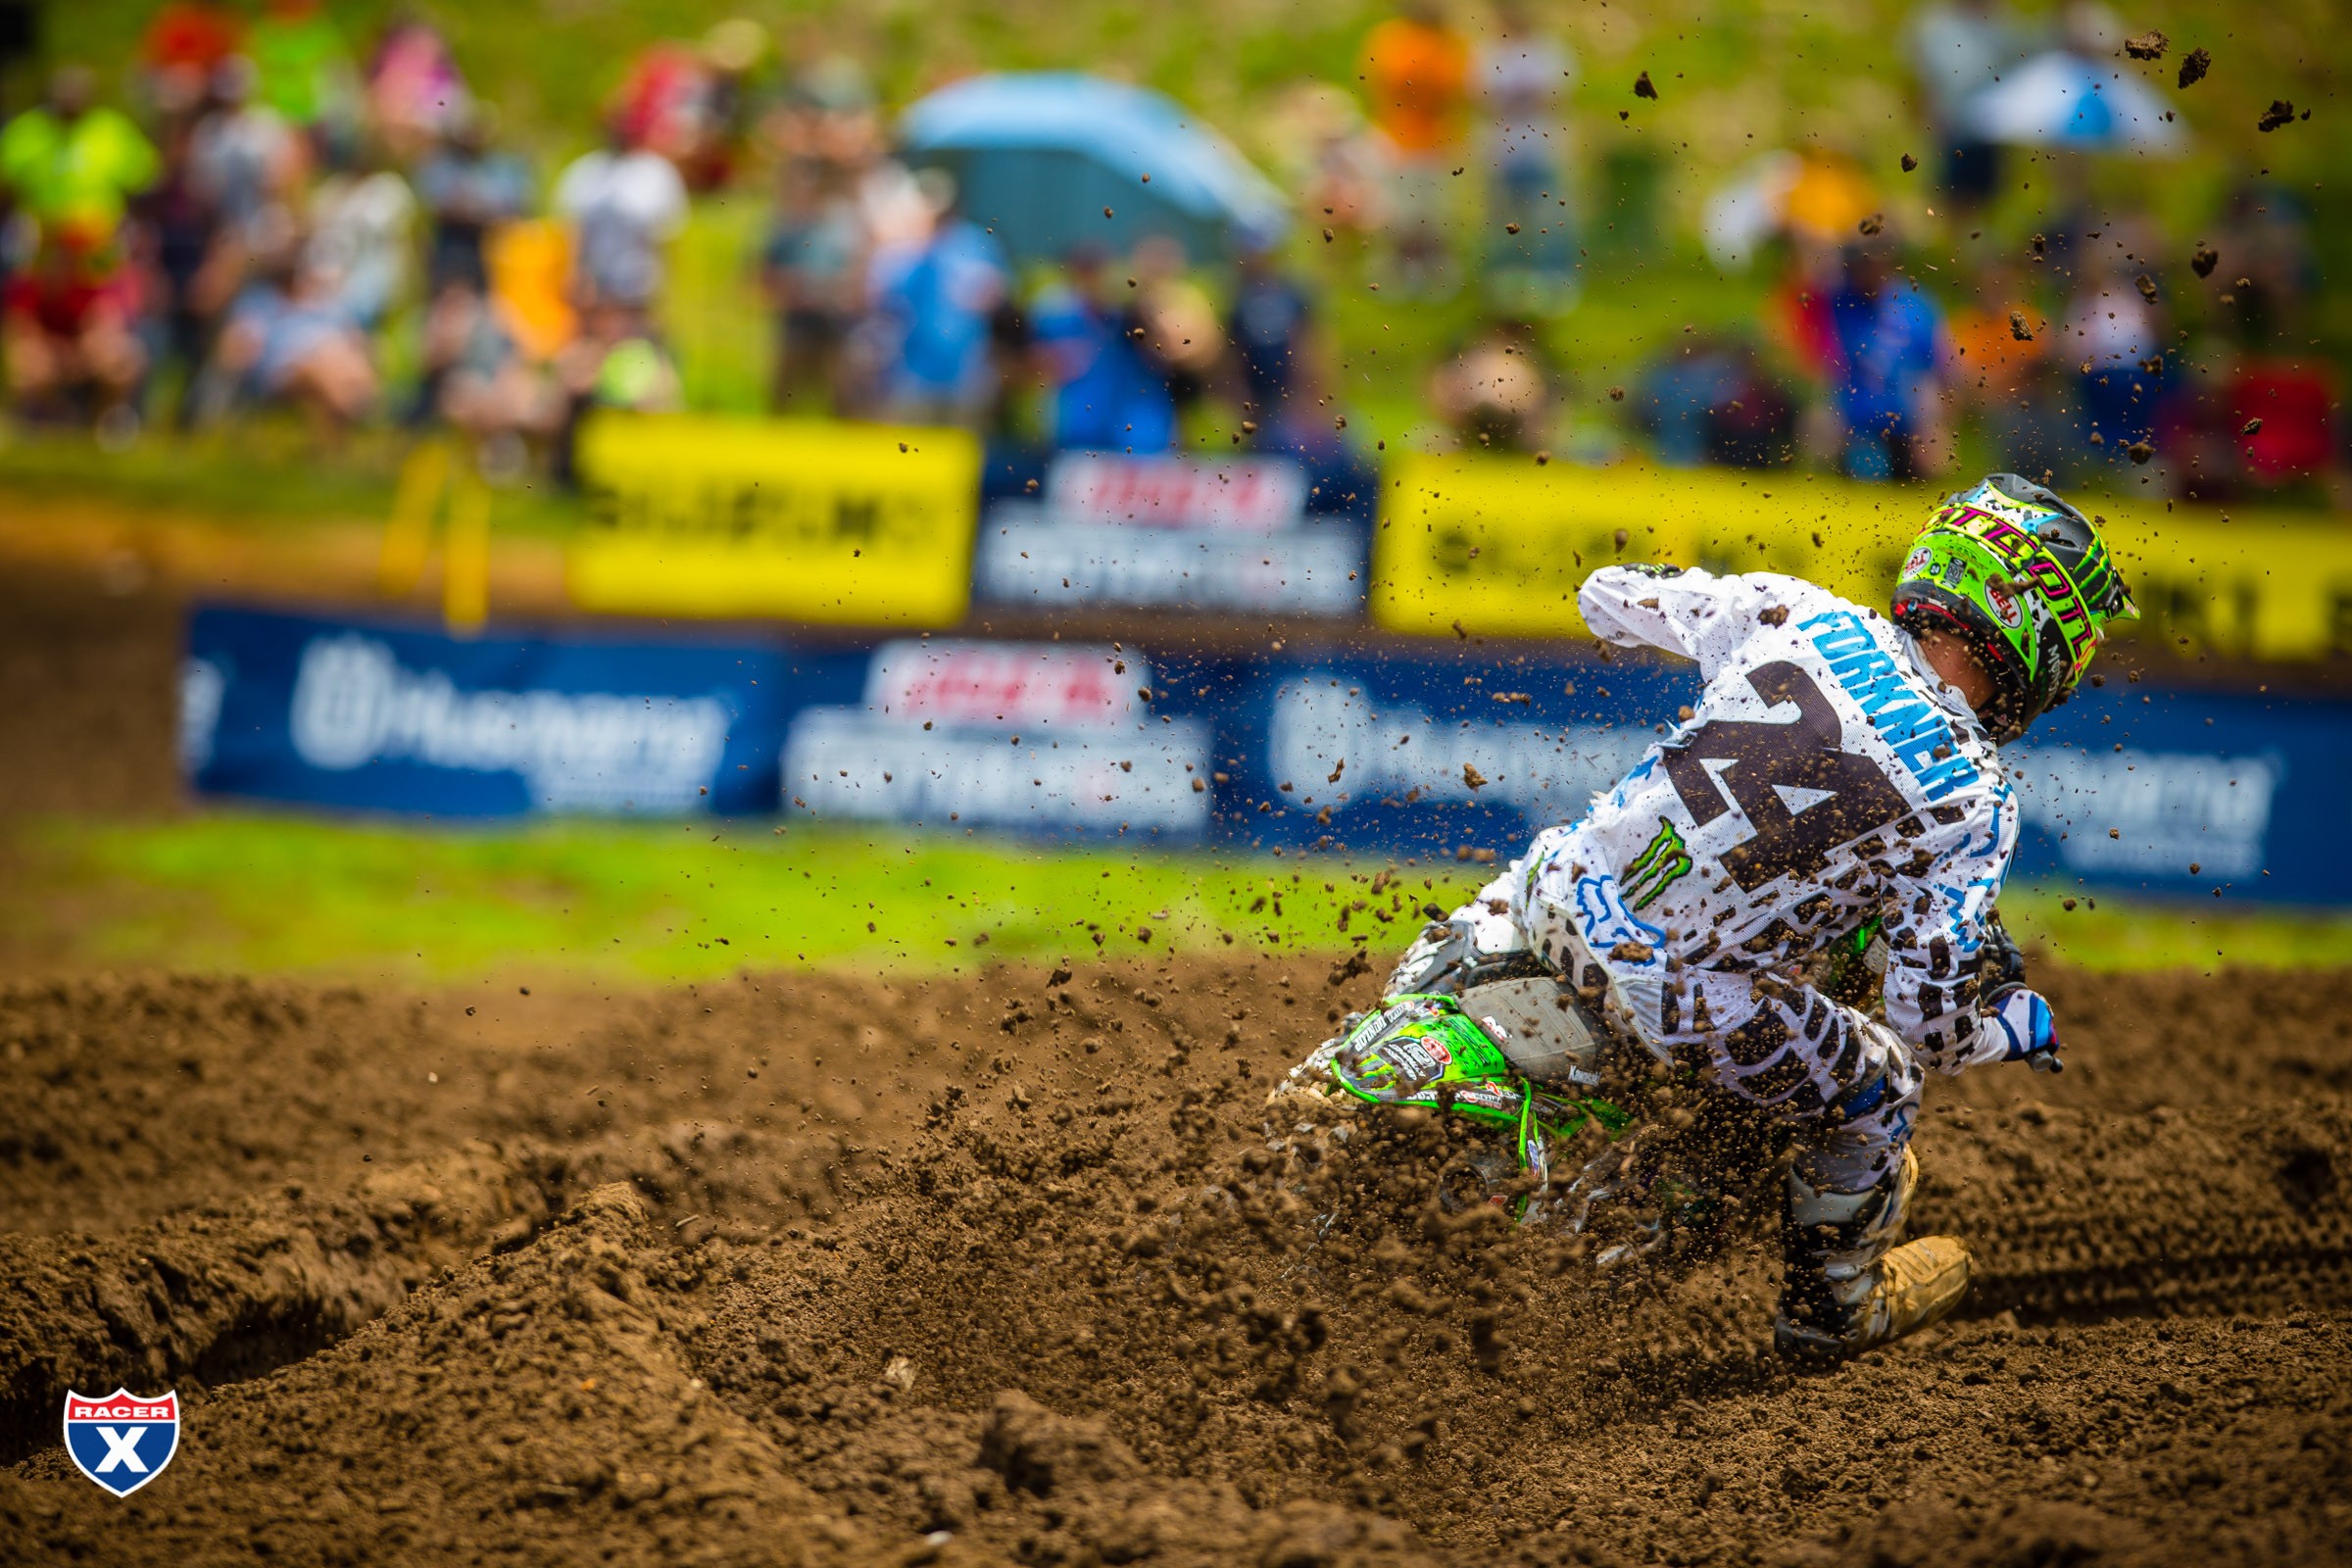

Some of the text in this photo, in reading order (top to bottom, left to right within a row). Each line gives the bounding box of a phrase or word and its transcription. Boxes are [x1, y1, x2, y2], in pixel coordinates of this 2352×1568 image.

[1988, 588, 2020, 624] BELL
[1666, 661, 1912, 894] 24
[1796, 610, 1980, 803] FORKNER
